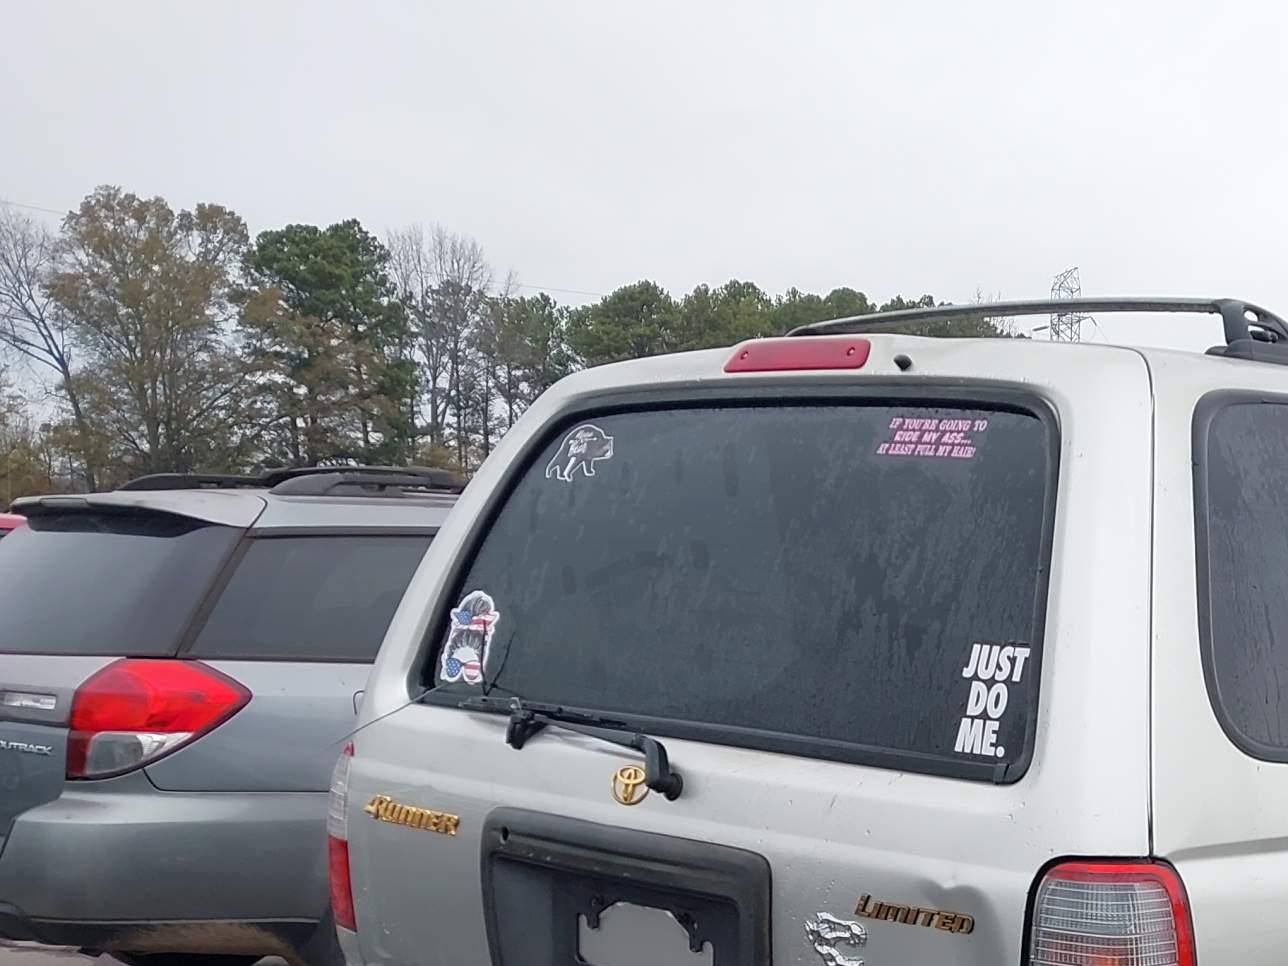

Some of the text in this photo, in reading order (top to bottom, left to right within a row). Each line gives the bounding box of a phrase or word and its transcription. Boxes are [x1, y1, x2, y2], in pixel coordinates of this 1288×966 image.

[889, 417, 988, 431] IF YOU'RE GOING TO
[894, 430, 972, 444] RIDE MY ASS...
[876, 443, 890, 454] AT
[888, 443, 916, 455] LEAST
[914, 444, 936, 456] PULL
[936, 445, 952, 457] MY
[962, 643, 1031, 682] JUST
[966, 680, 1009, 719] DO
[954, 717, 1006, 758] ME.
[855, 894, 976, 935] LIMITED
